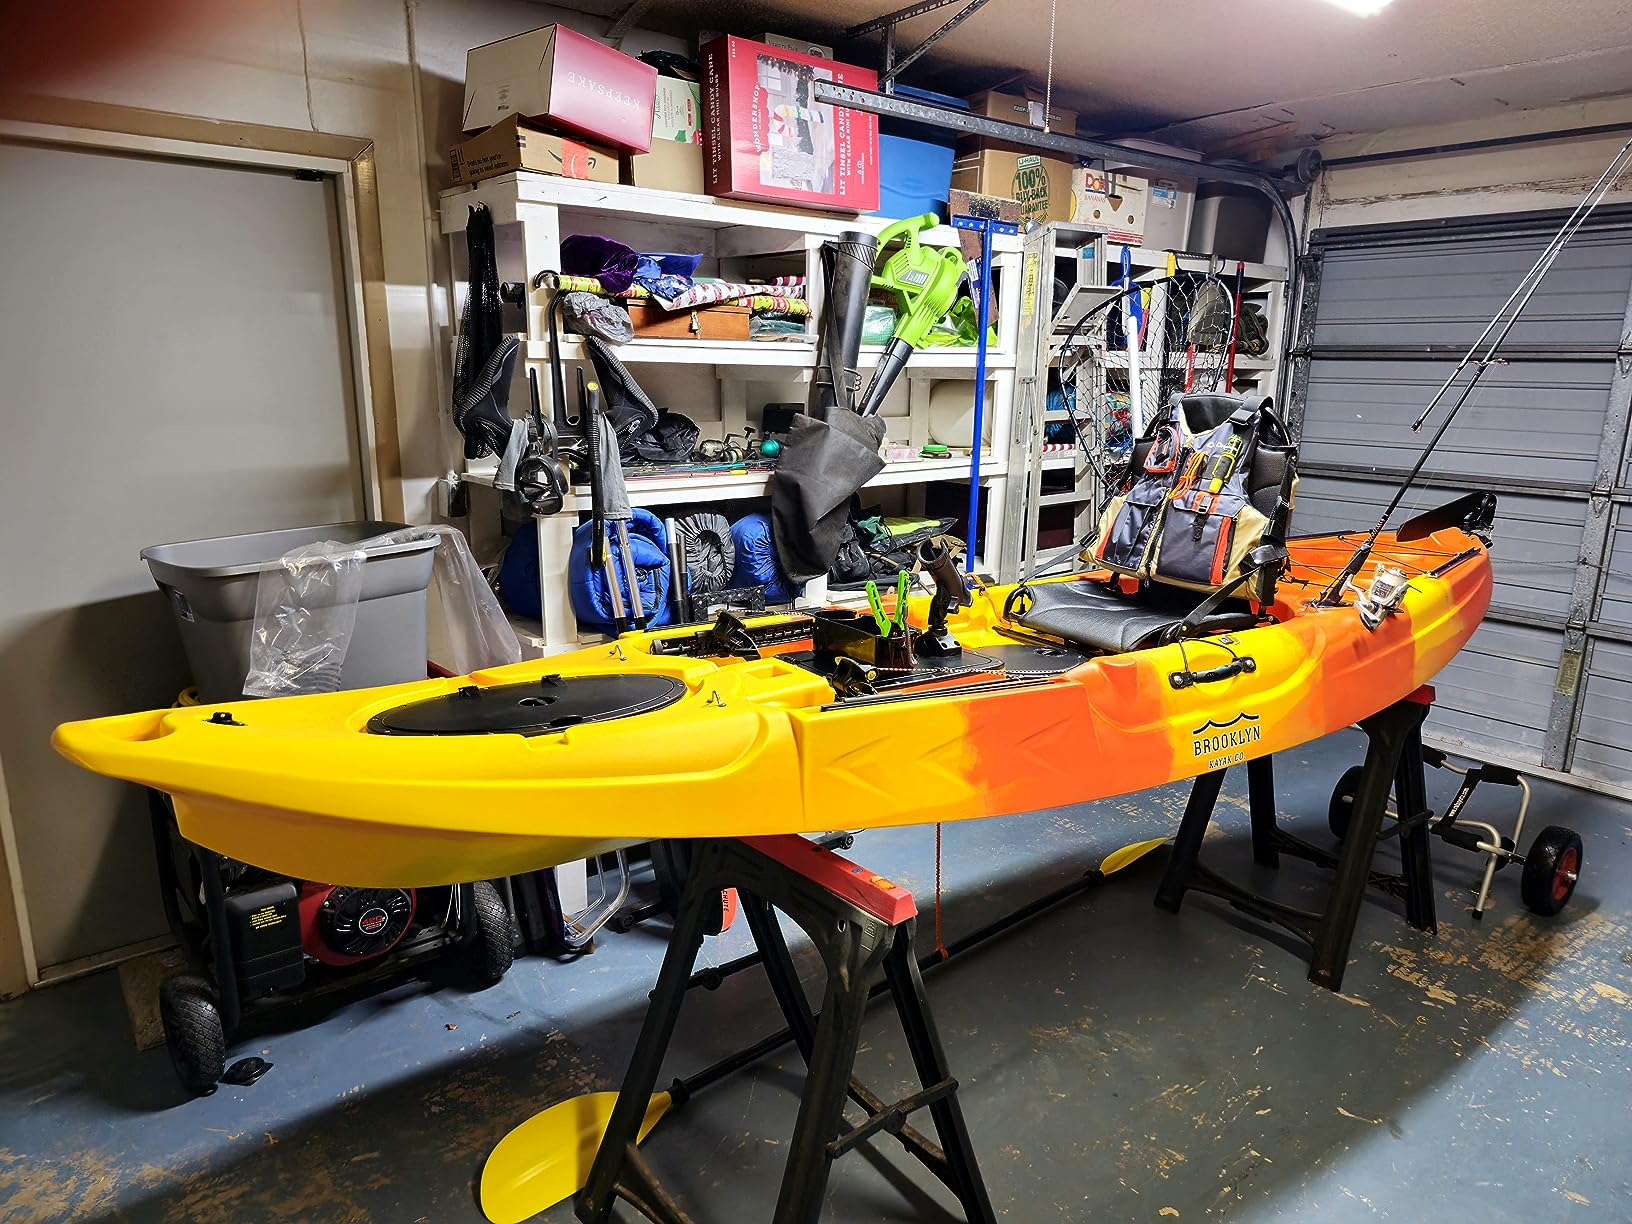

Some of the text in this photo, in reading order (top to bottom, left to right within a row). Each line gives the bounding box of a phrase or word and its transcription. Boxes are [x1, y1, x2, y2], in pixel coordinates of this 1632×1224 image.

[568, 72, 640, 110] KEEPSAKE
[751, 83, 762, 153] WONDERSHOP
[1015, 168, 1046, 191] 100%
[1015, 185, 1048, 201] BUY-BACK
[1020, 199, 1049, 215] UARANTEE
[1194, 726, 1260, 756] BROOKLYN
[1209, 751, 1246, 769] KAYAK CO.
